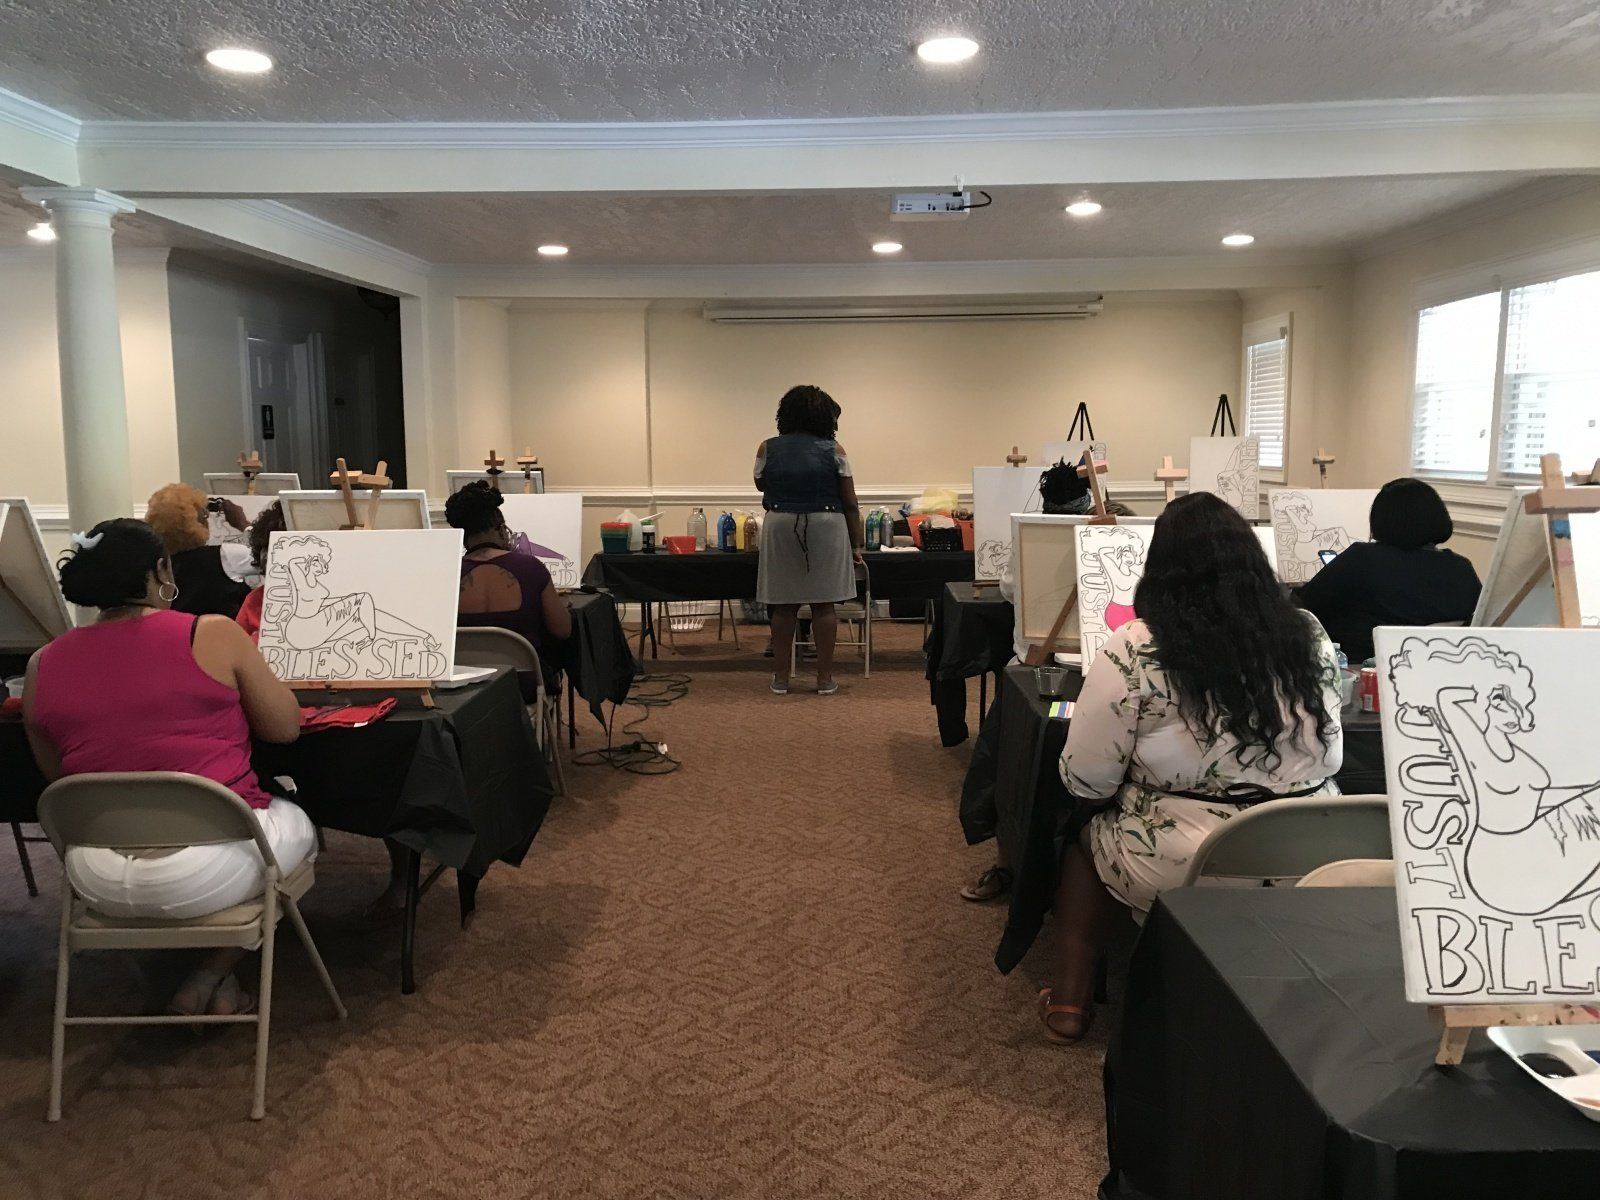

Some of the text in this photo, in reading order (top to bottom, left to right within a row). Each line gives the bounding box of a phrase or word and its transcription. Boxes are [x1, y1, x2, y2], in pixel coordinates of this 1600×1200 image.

[261, 564, 294, 644] JUST
[1080, 551, 1111, 631] JUST
[260, 637, 448, 681] BLESSED
[1394, 704, 1470, 899] JUST
[1411, 893, 1600, 995] BLE
